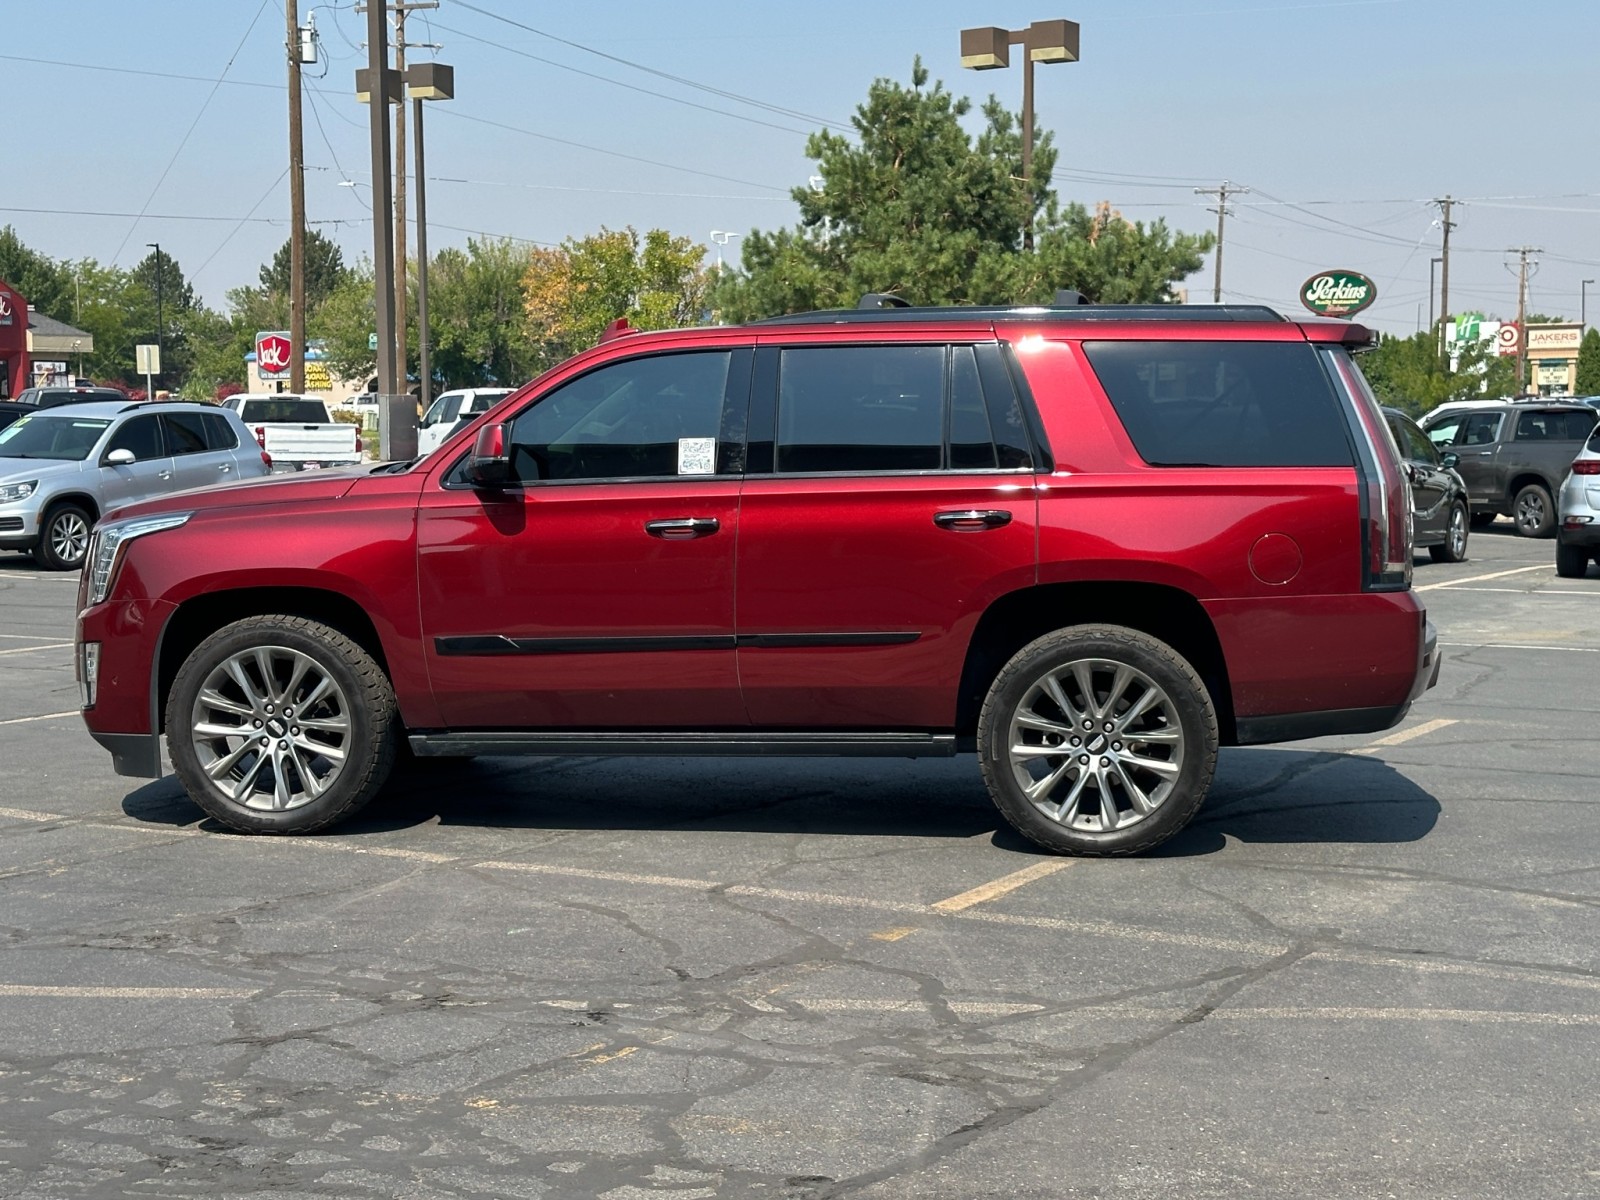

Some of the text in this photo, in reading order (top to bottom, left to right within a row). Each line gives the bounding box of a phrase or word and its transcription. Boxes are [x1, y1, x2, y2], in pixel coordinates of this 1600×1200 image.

[1306, 277, 1367, 300] Perkins
[1531, 333, 1577, 342] JAKERS
[259, 339, 291, 366] Jack
[1500, 345, 1518, 353] arget
